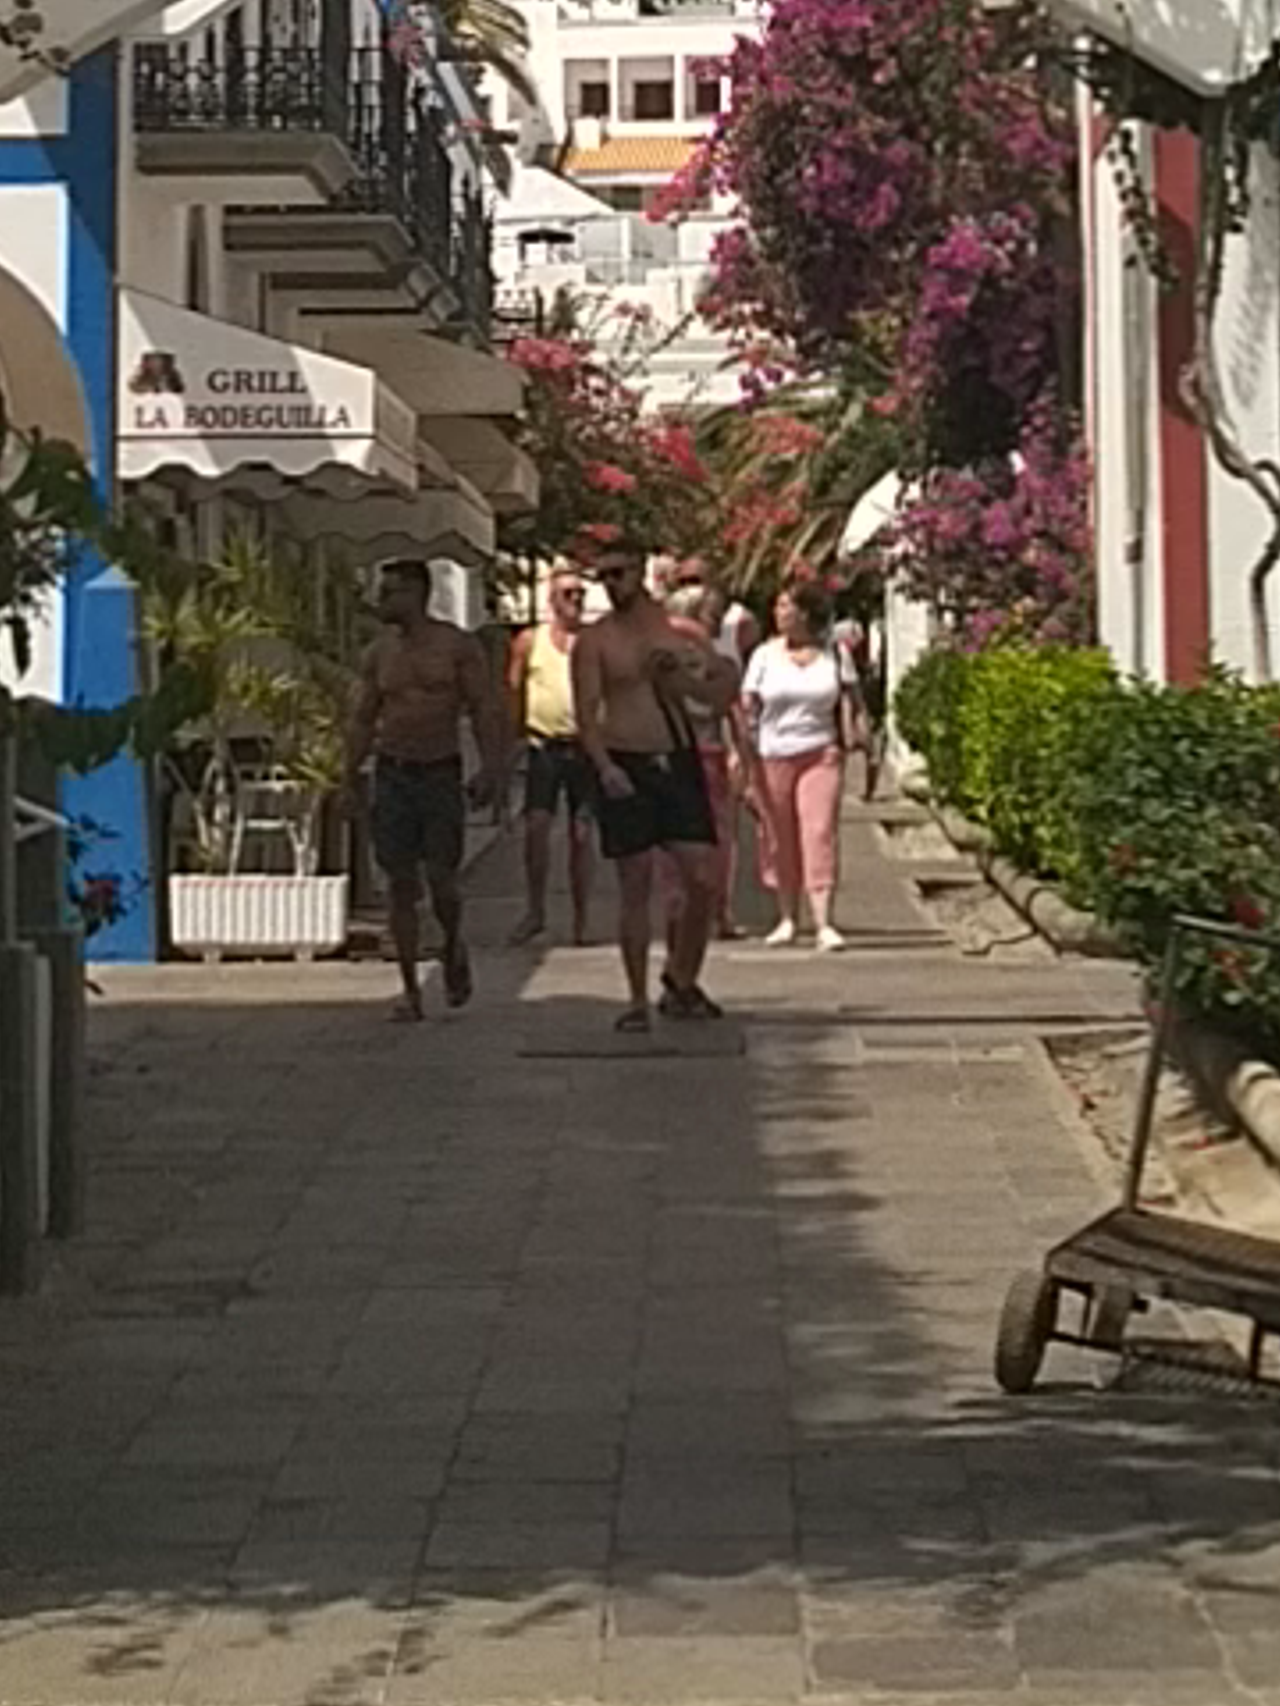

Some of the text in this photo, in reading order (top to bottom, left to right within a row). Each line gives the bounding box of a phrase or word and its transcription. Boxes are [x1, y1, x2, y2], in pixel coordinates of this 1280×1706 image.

[206, 369, 308, 394] GRILL
[135, 405, 352, 429] LA BODEGUILLA
